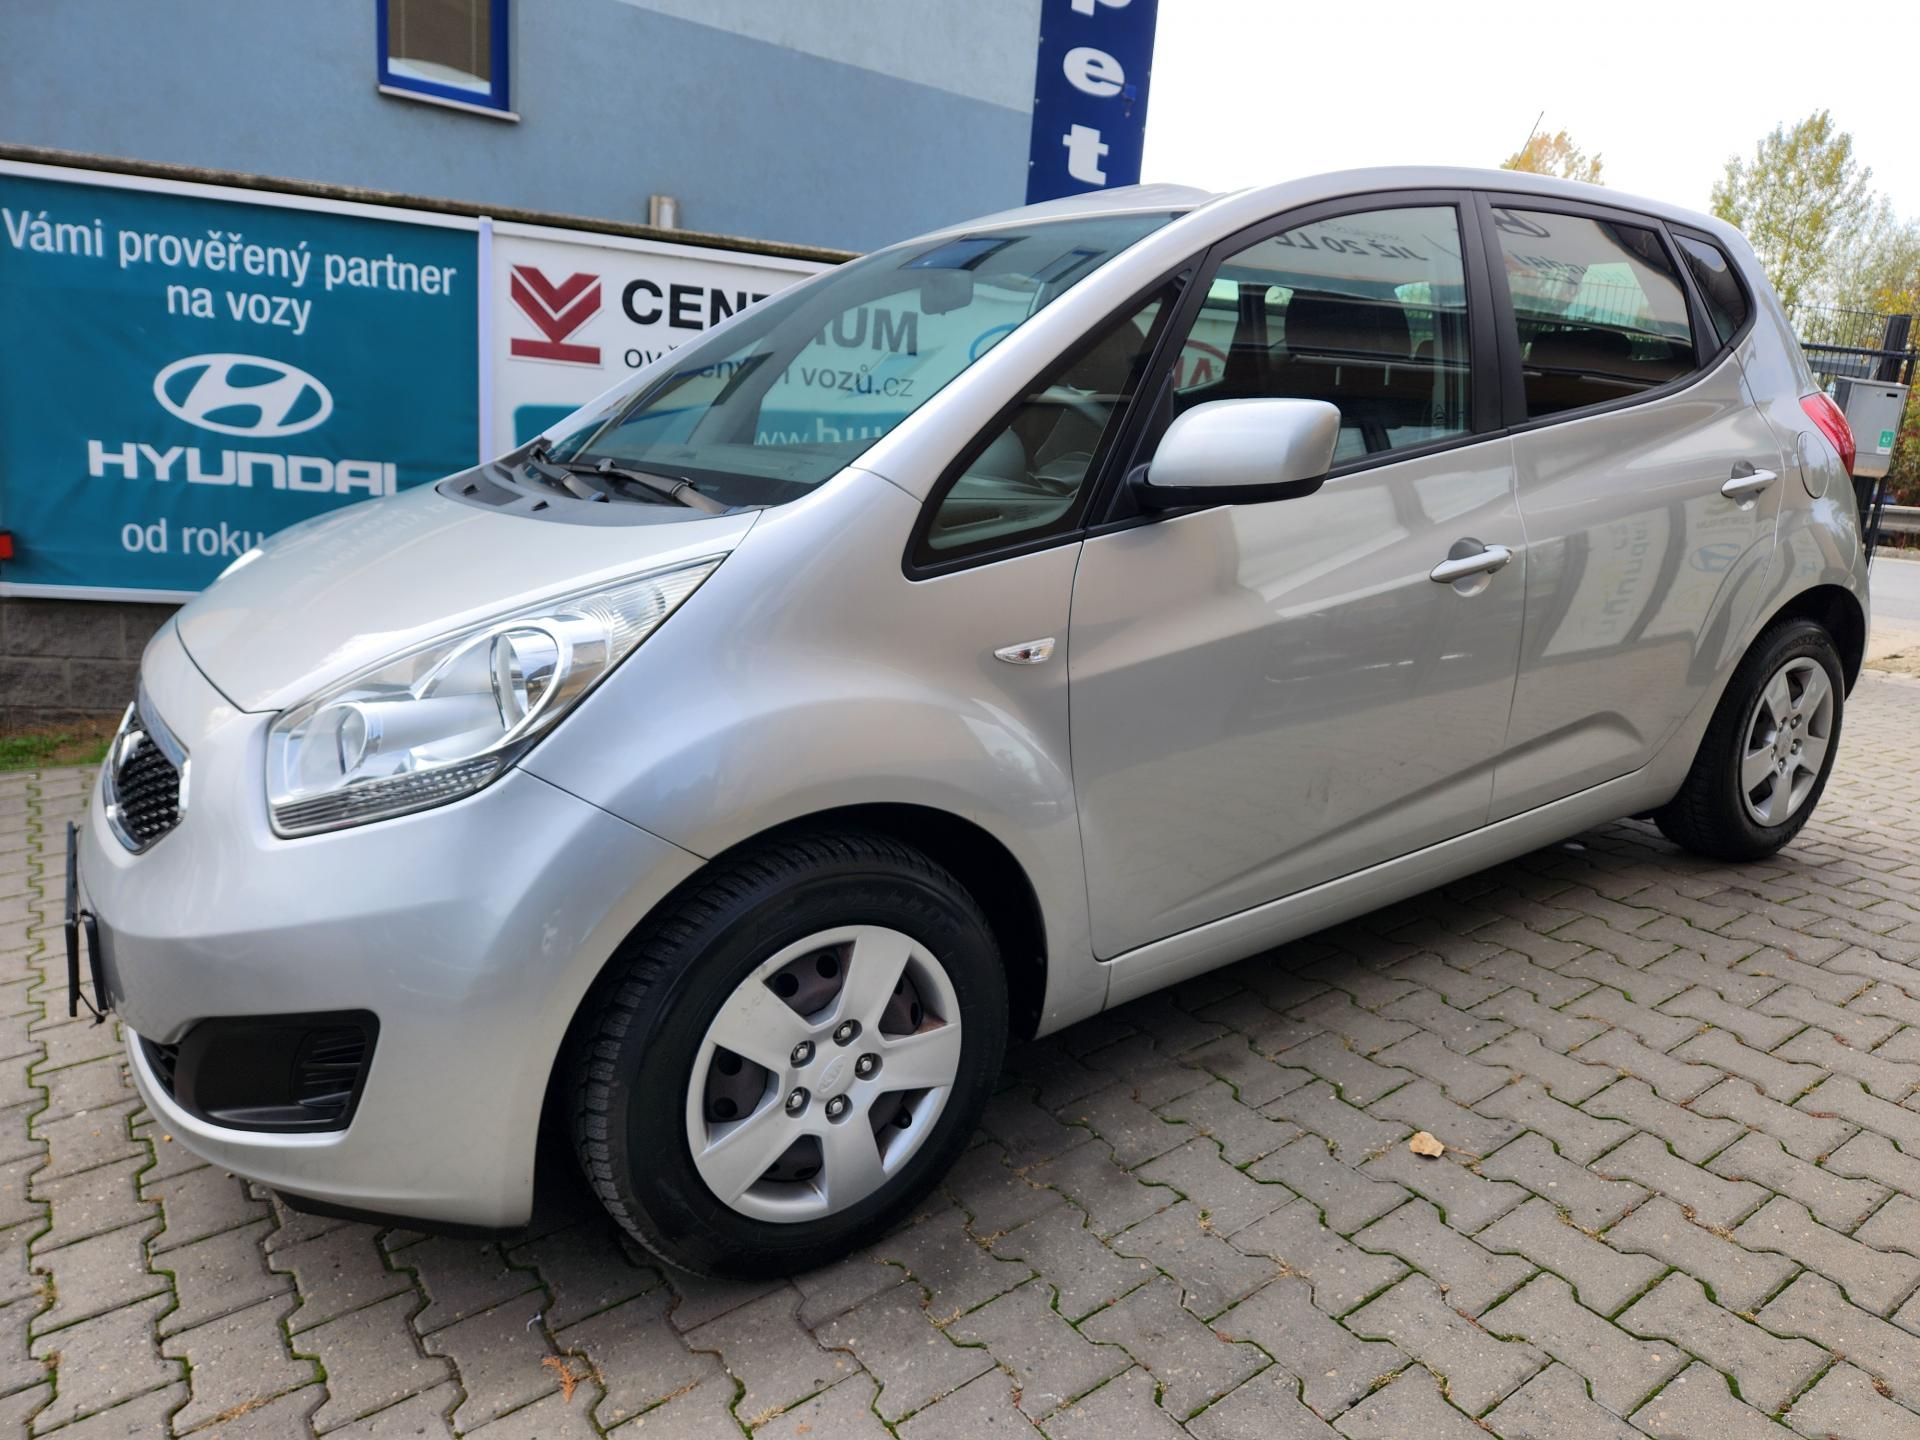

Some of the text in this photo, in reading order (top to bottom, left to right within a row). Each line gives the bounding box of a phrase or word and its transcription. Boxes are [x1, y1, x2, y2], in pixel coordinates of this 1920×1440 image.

[1063, 0, 1132, 187] et
[2, 208, 457, 295] Vámi prověřený partner
[166, 284, 312, 335] na vozy
[88, 439, 397, 497] HYUNDAI
[121, 517, 168, 554] od
